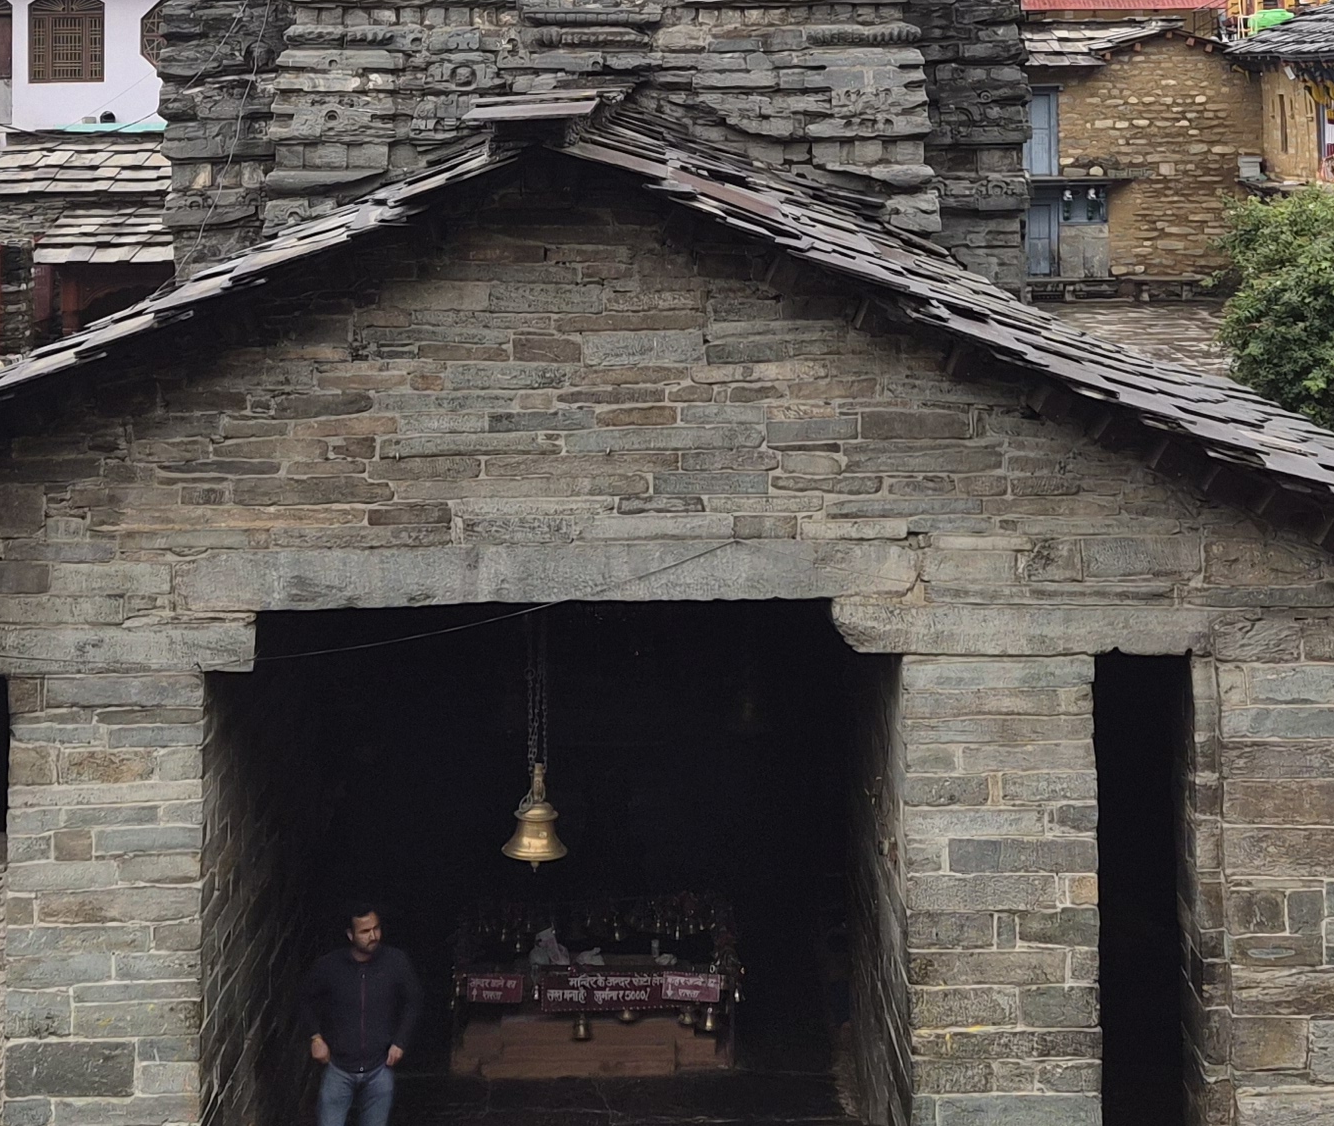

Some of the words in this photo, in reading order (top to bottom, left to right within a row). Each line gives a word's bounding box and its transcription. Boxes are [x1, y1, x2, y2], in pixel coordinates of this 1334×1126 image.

[568, 973, 597, 989] मन्दिर
[597, 973, 605, 987] के
[606, 976, 630, 988] अन्दर
[631, 973, 651, 986] फोटो
